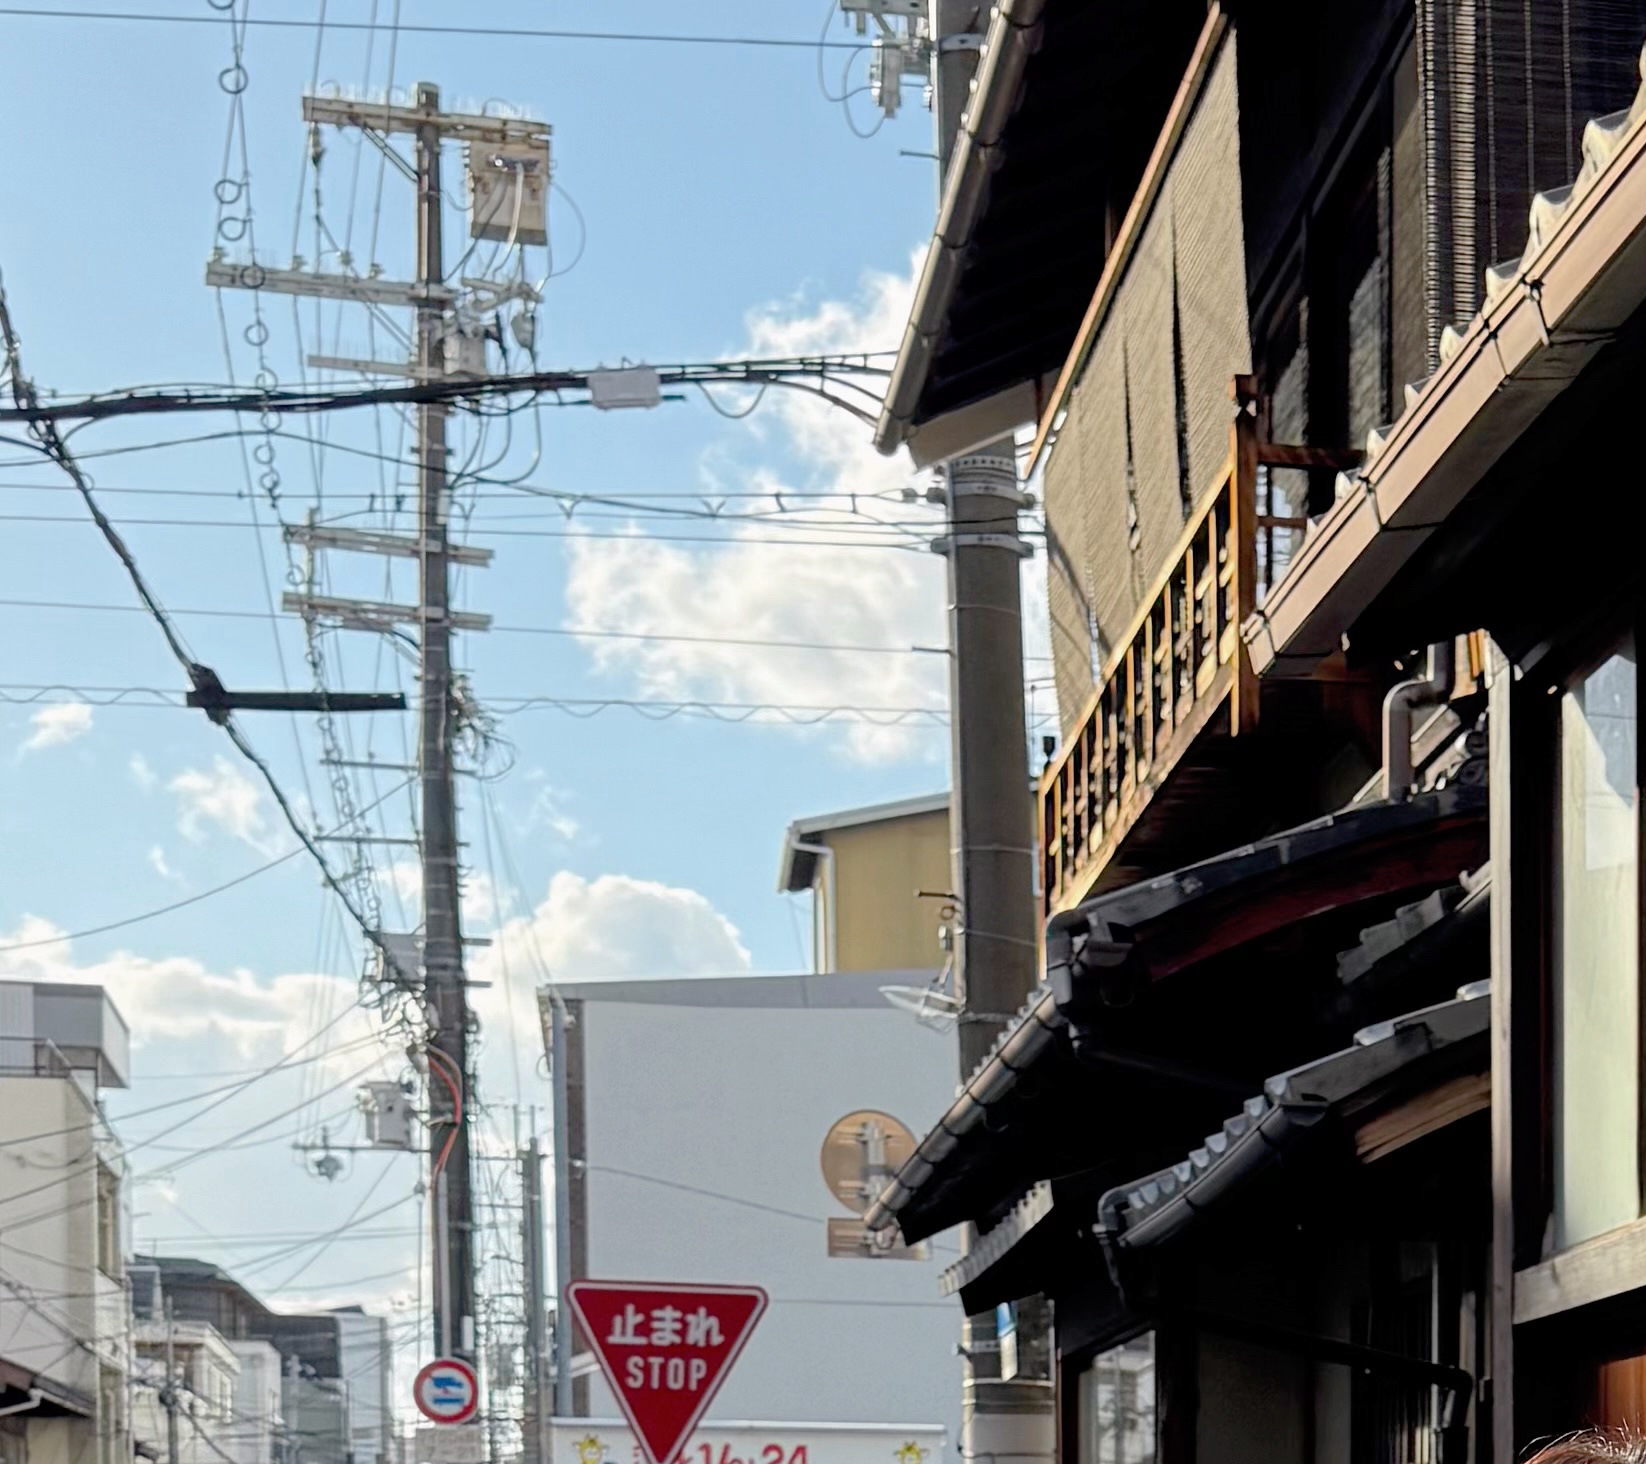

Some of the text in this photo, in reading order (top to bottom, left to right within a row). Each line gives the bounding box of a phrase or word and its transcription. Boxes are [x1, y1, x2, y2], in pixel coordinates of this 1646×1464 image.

[606, 1303, 725, 1347] 止まれ
[625, 1355, 707, 1391] STOP
